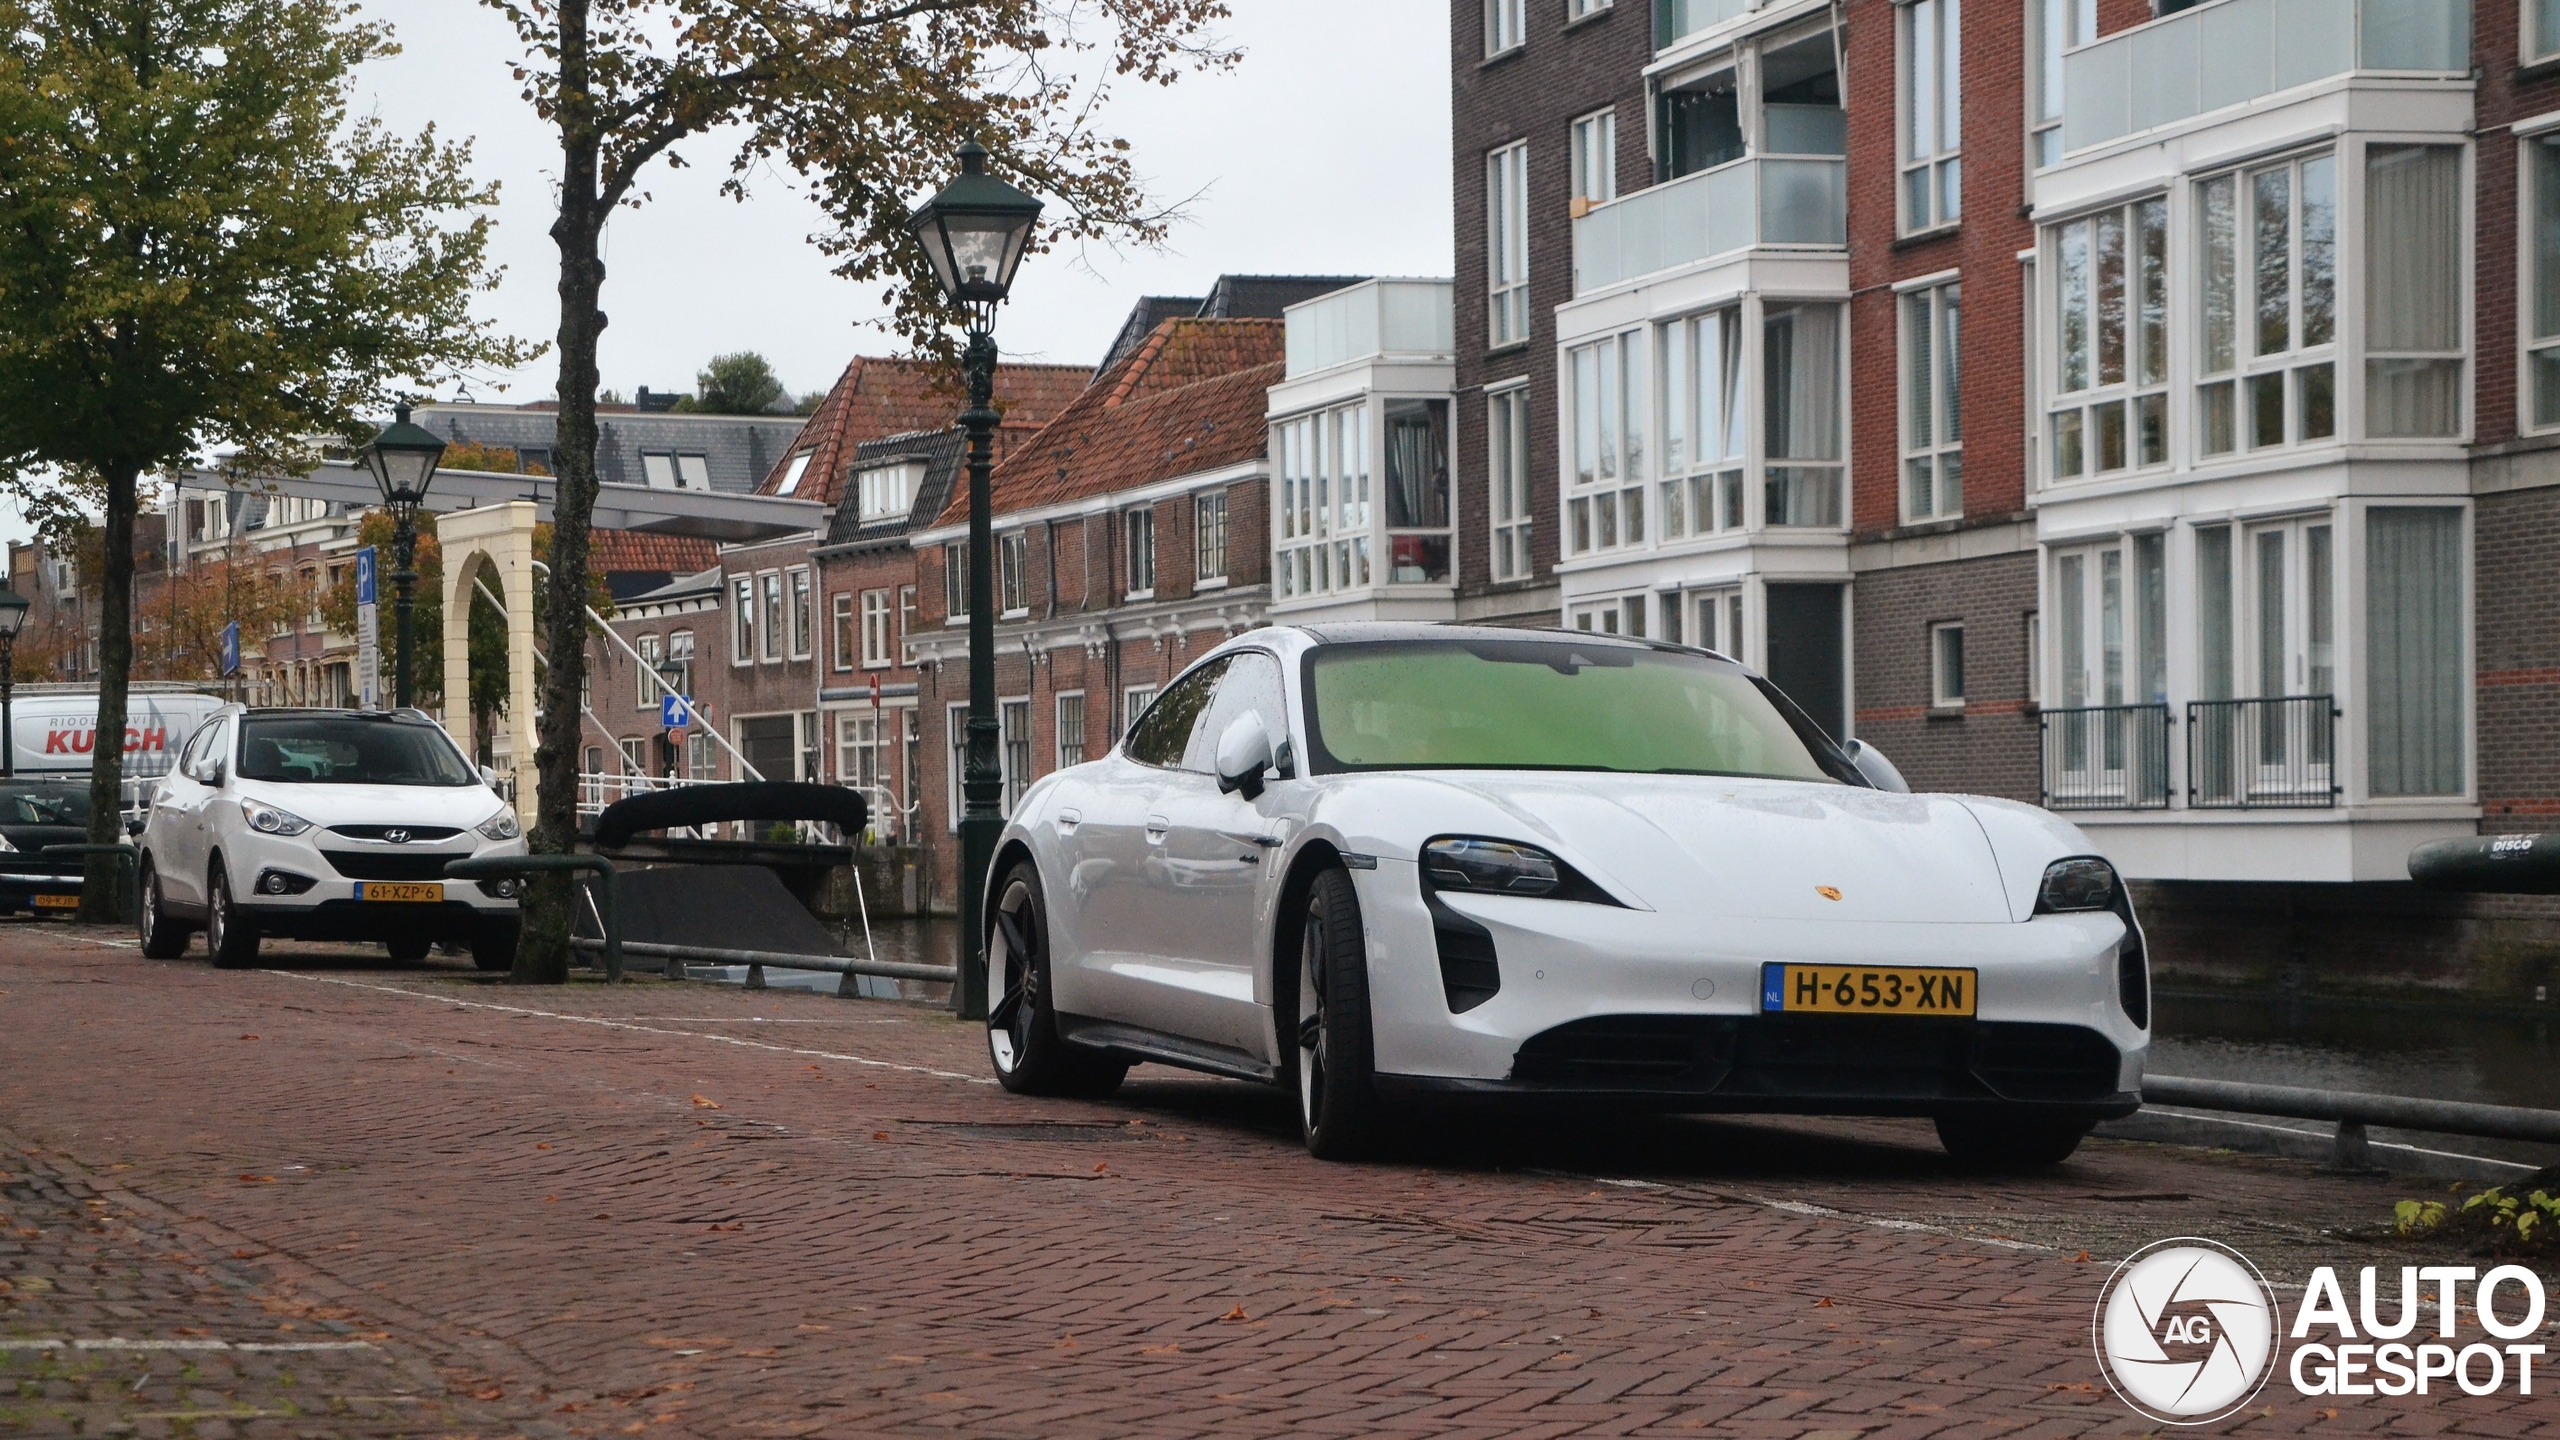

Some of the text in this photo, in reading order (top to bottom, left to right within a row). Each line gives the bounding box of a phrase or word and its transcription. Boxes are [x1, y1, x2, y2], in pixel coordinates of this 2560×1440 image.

[360, 556, 368, 598] P
[46, 727, 165, 754] KUCH
[2493, 839, 2532, 852] DISCO
[371, 885, 434, 899] 61-XZP-6
[38, 896, 80, 906] 09-KJP-
[1767, 991, 1781, 1003] NL
[1796, 971, 1963, 1009] H-653-XN
